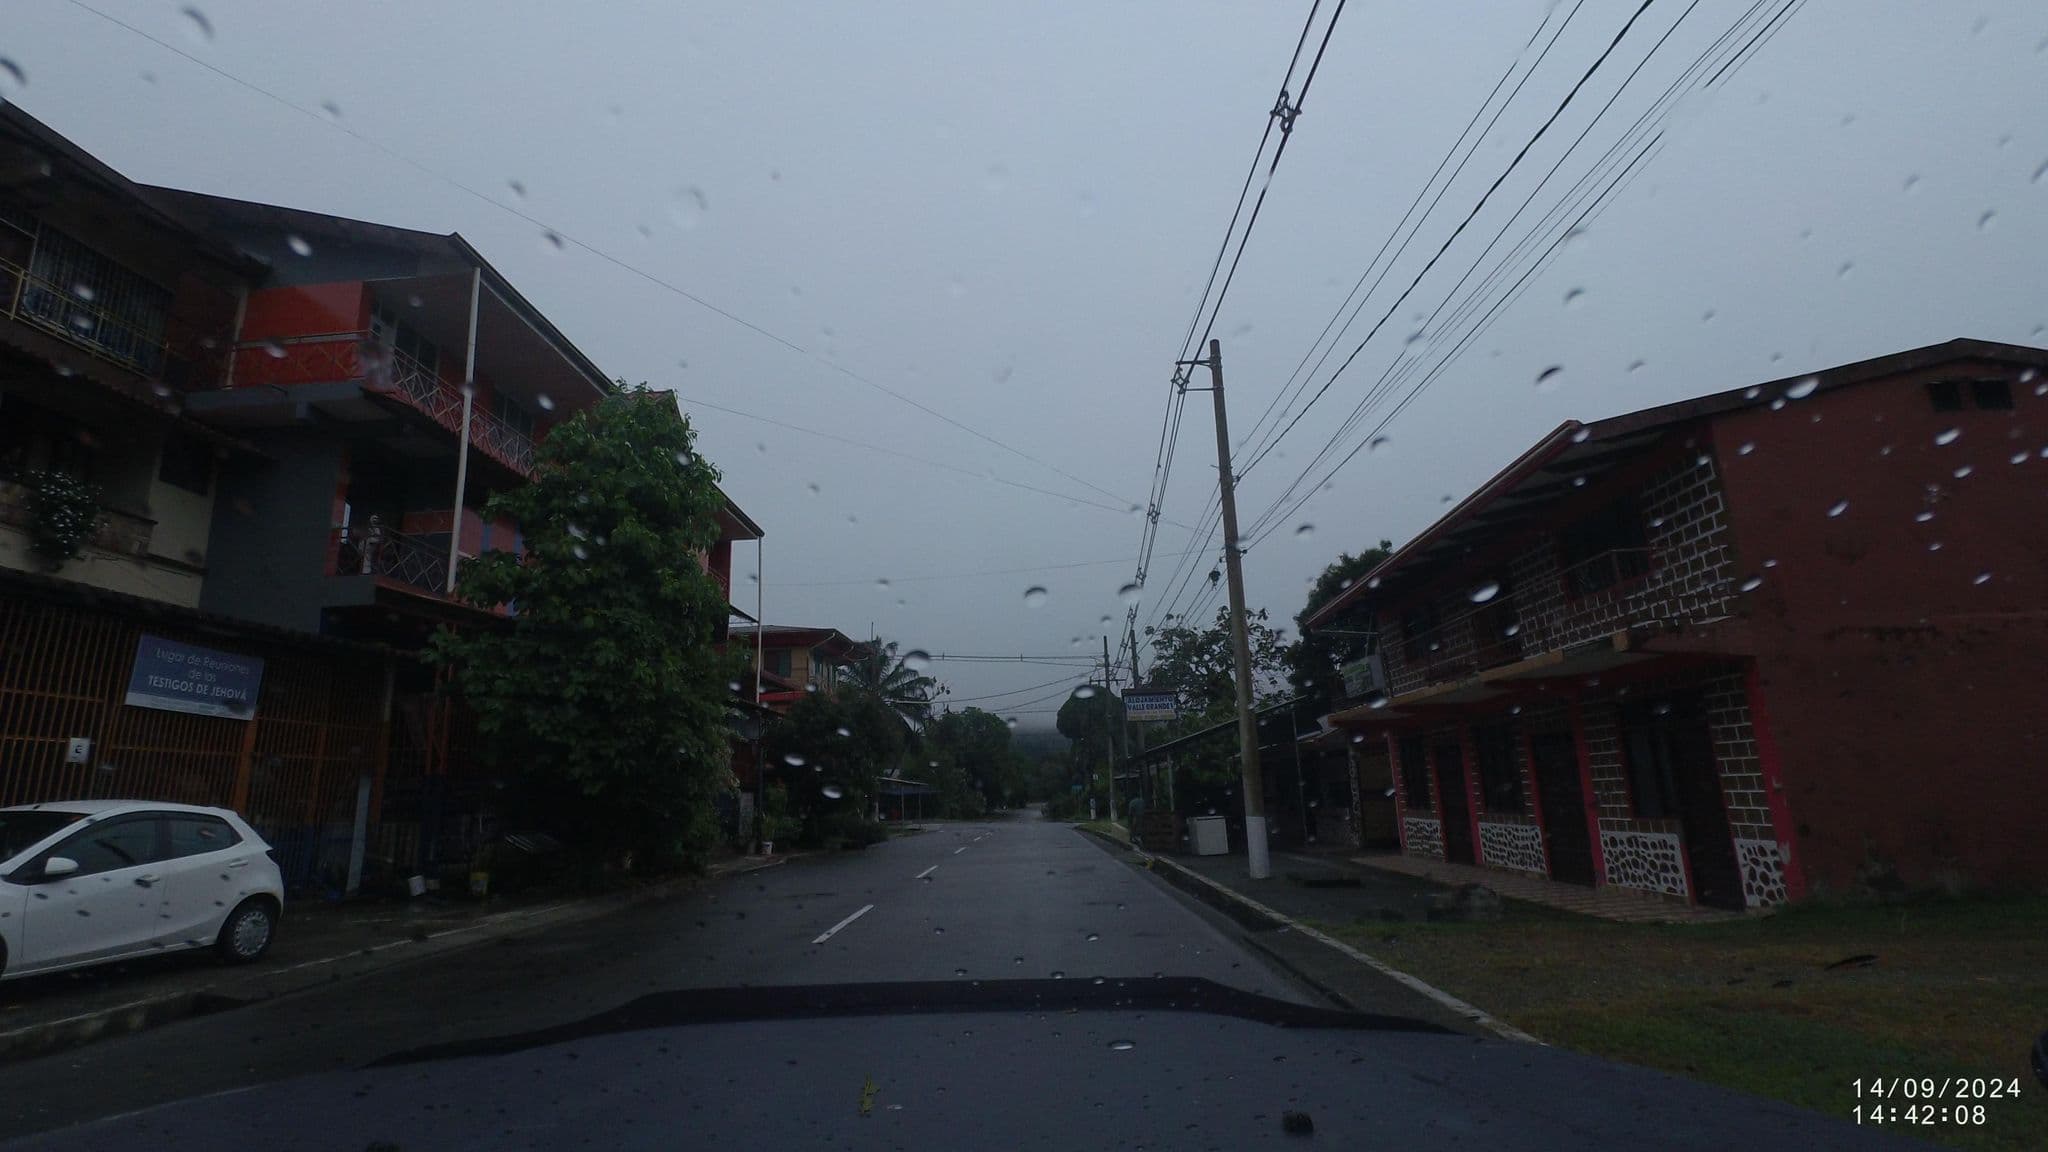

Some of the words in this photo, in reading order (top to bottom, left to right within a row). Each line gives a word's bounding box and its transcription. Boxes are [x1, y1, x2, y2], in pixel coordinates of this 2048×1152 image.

[155, 647, 184, 664] Lugar
[187, 655, 201, 666] de
[188, 669, 201, 679] de
[204, 671, 217, 682] los
[148, 674, 194, 693] TESTIGOS
[195, 683, 209, 695] DE
[211, 686, 247, 701] JEHOVÁ
